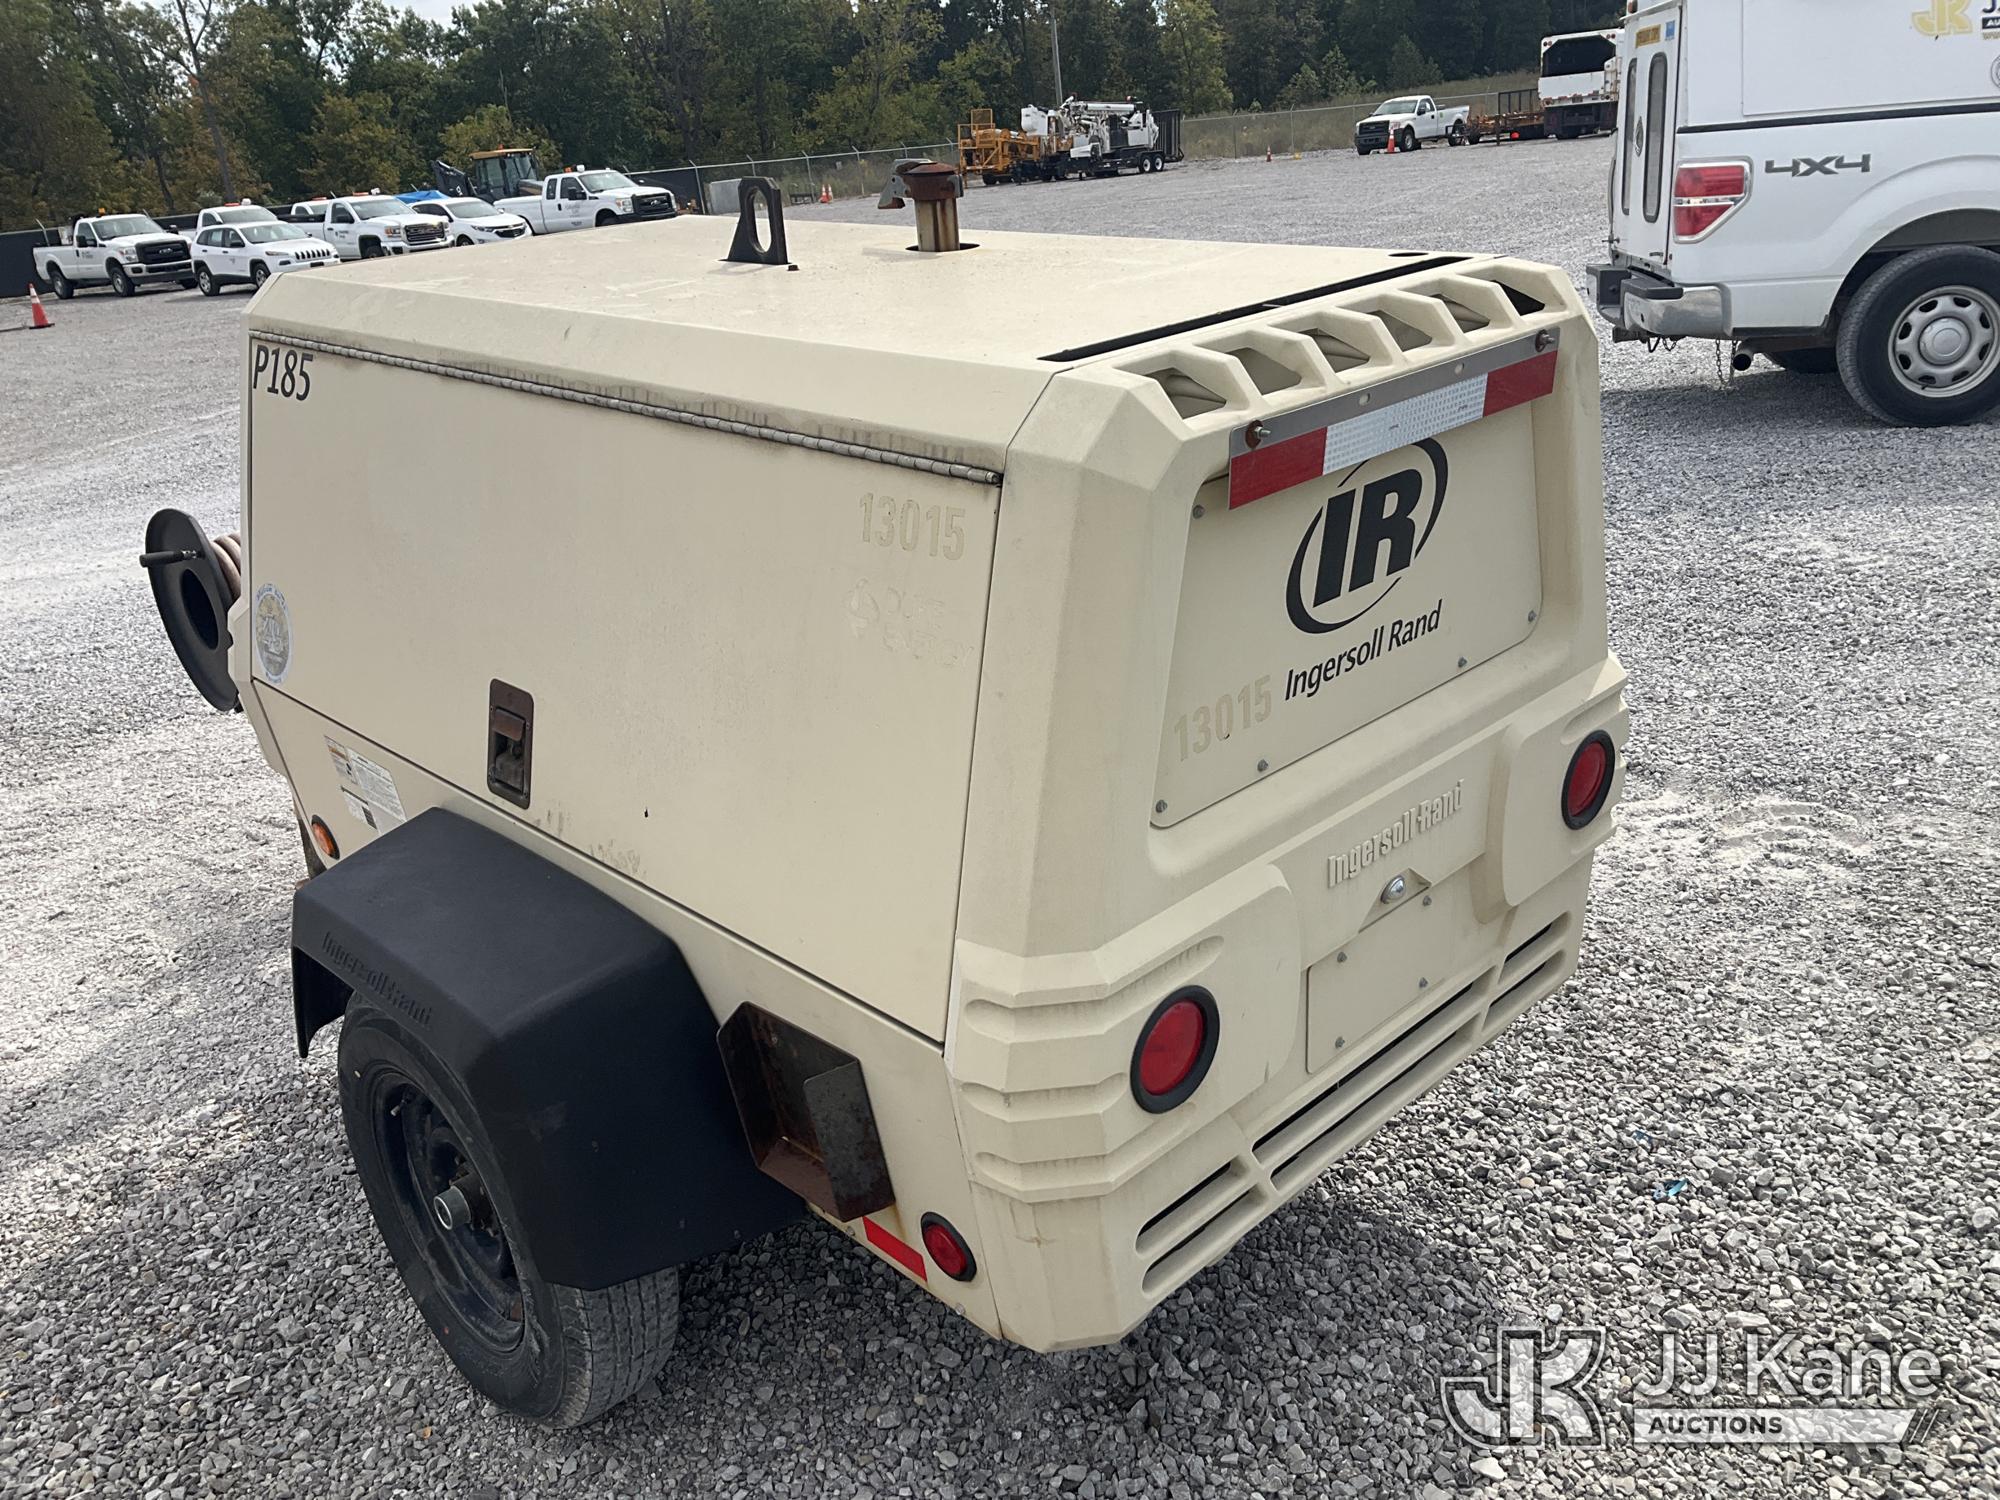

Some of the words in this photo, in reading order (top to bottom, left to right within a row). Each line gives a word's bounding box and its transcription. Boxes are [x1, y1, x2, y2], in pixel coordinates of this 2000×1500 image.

[252, 344, 314, 401] P185
[859, 491, 967, 562] 13015
[1312, 468, 1423, 608] IR
[1285, 625, 1385, 701] Ingersoll
[1387, 598, 1443, 652] Rand
[1173, 673, 1272, 763] 13015
